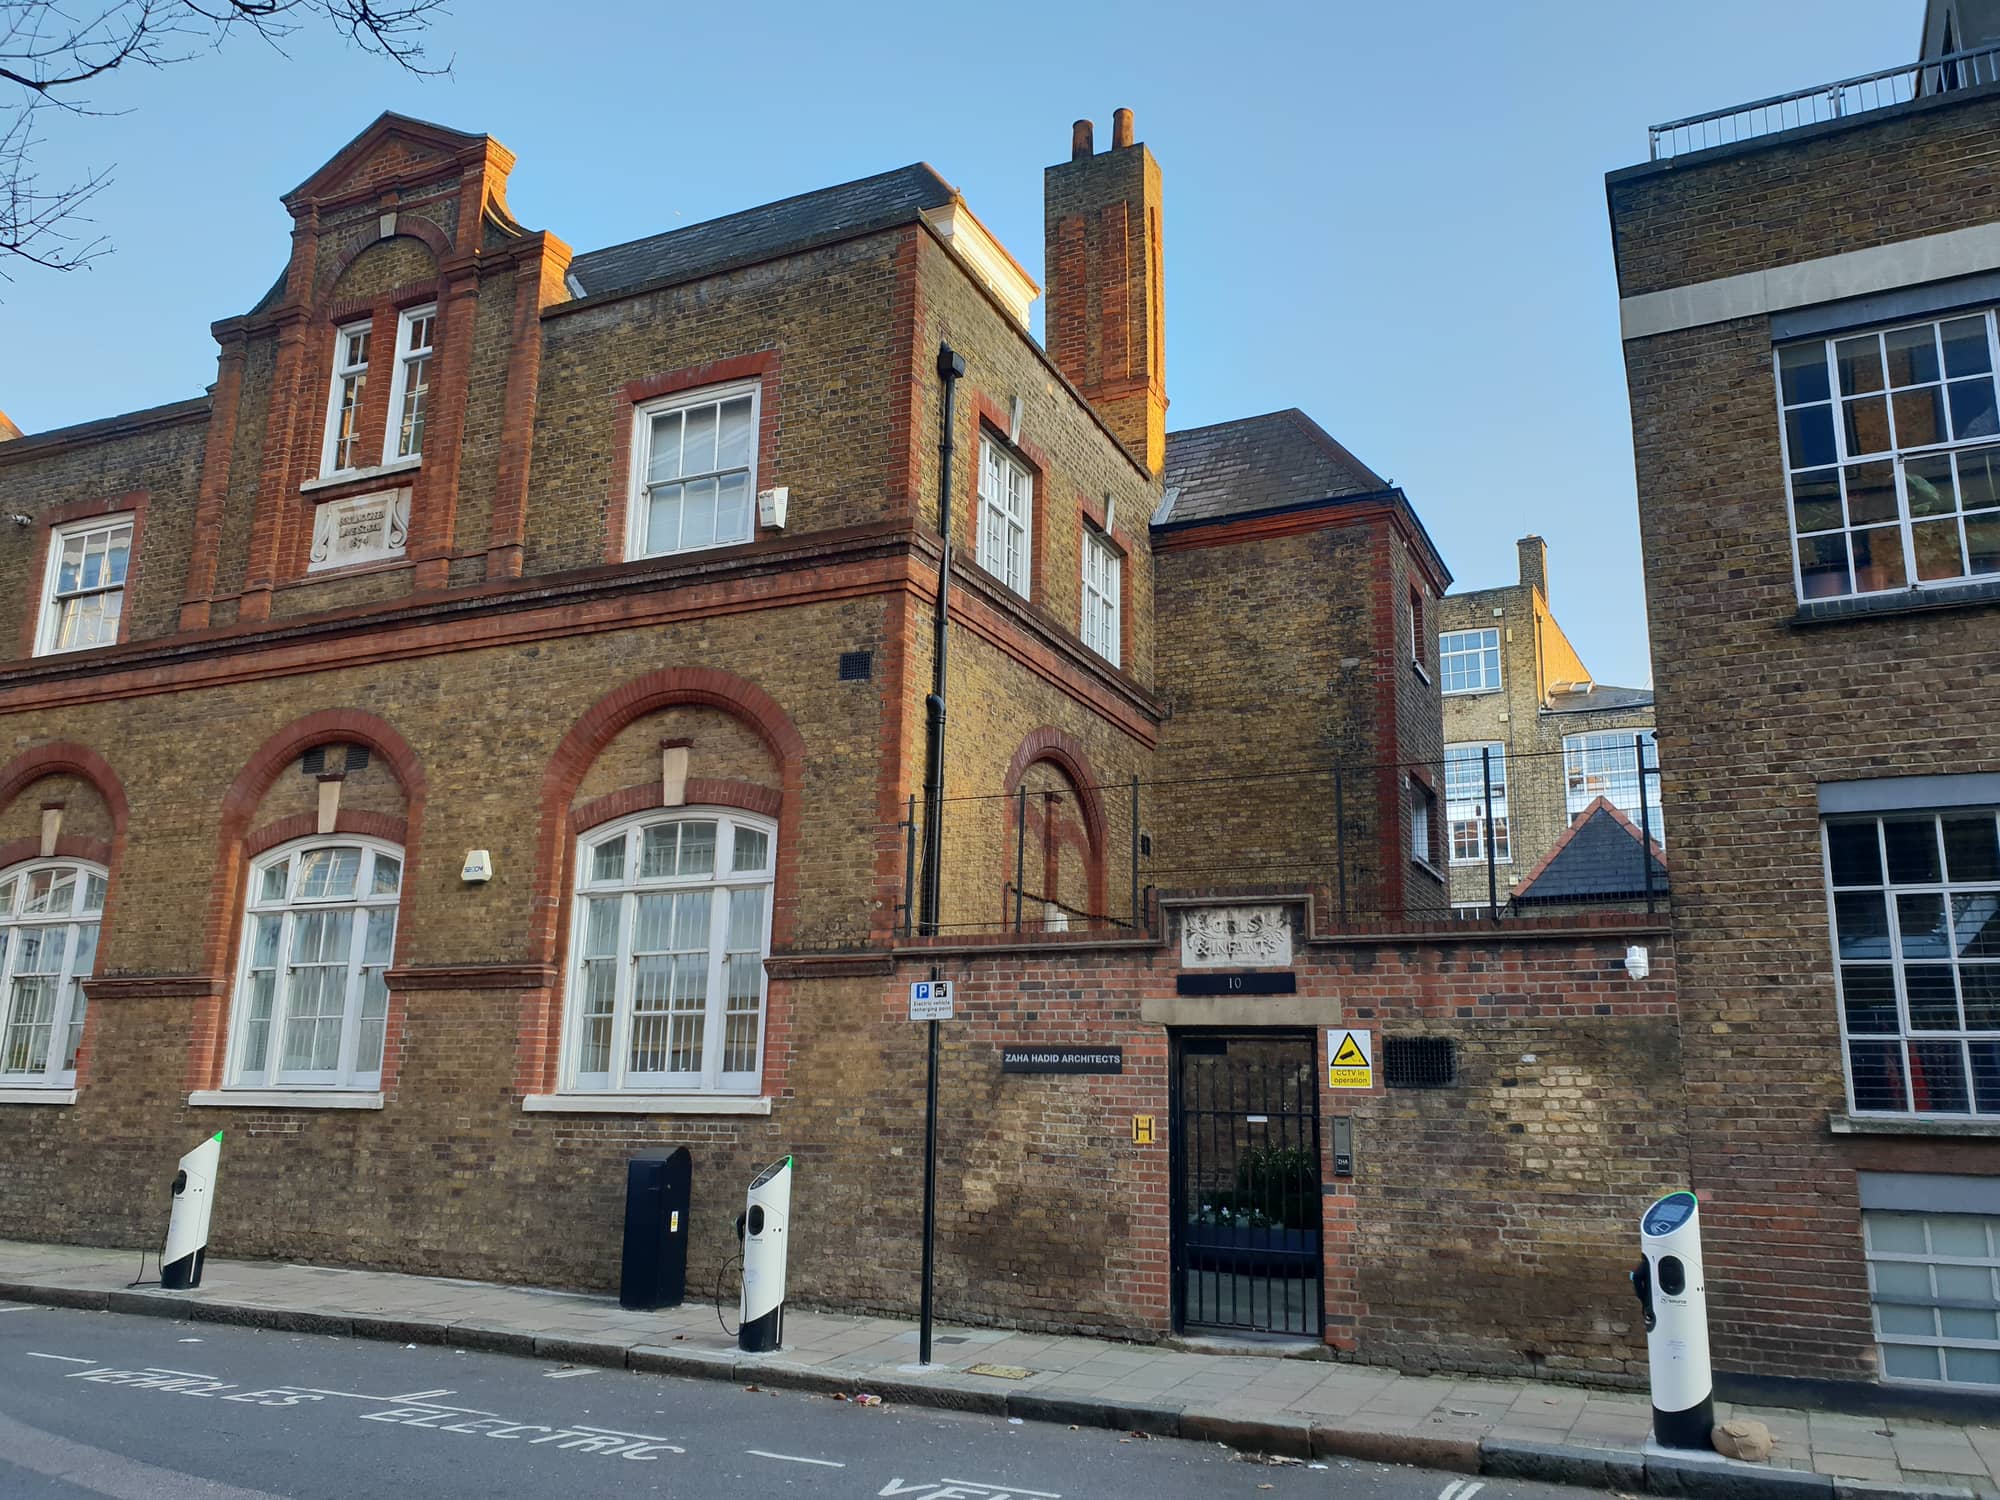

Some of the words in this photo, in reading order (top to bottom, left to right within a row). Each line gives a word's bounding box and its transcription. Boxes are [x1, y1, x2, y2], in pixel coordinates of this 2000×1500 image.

[1229, 977, 1242, 989] 10
[1005, 1053, 1029, 1063] ZAHA
[1031, 1054, 1060, 1063] HADID
[1061, 1054, 1121, 1064] ARCHITECTS
[1334, 1077, 1368, 1085] operation
[64, 1368, 325, 1406] VEHICLES
[359, 1407, 686, 1460] ELECTRIC
